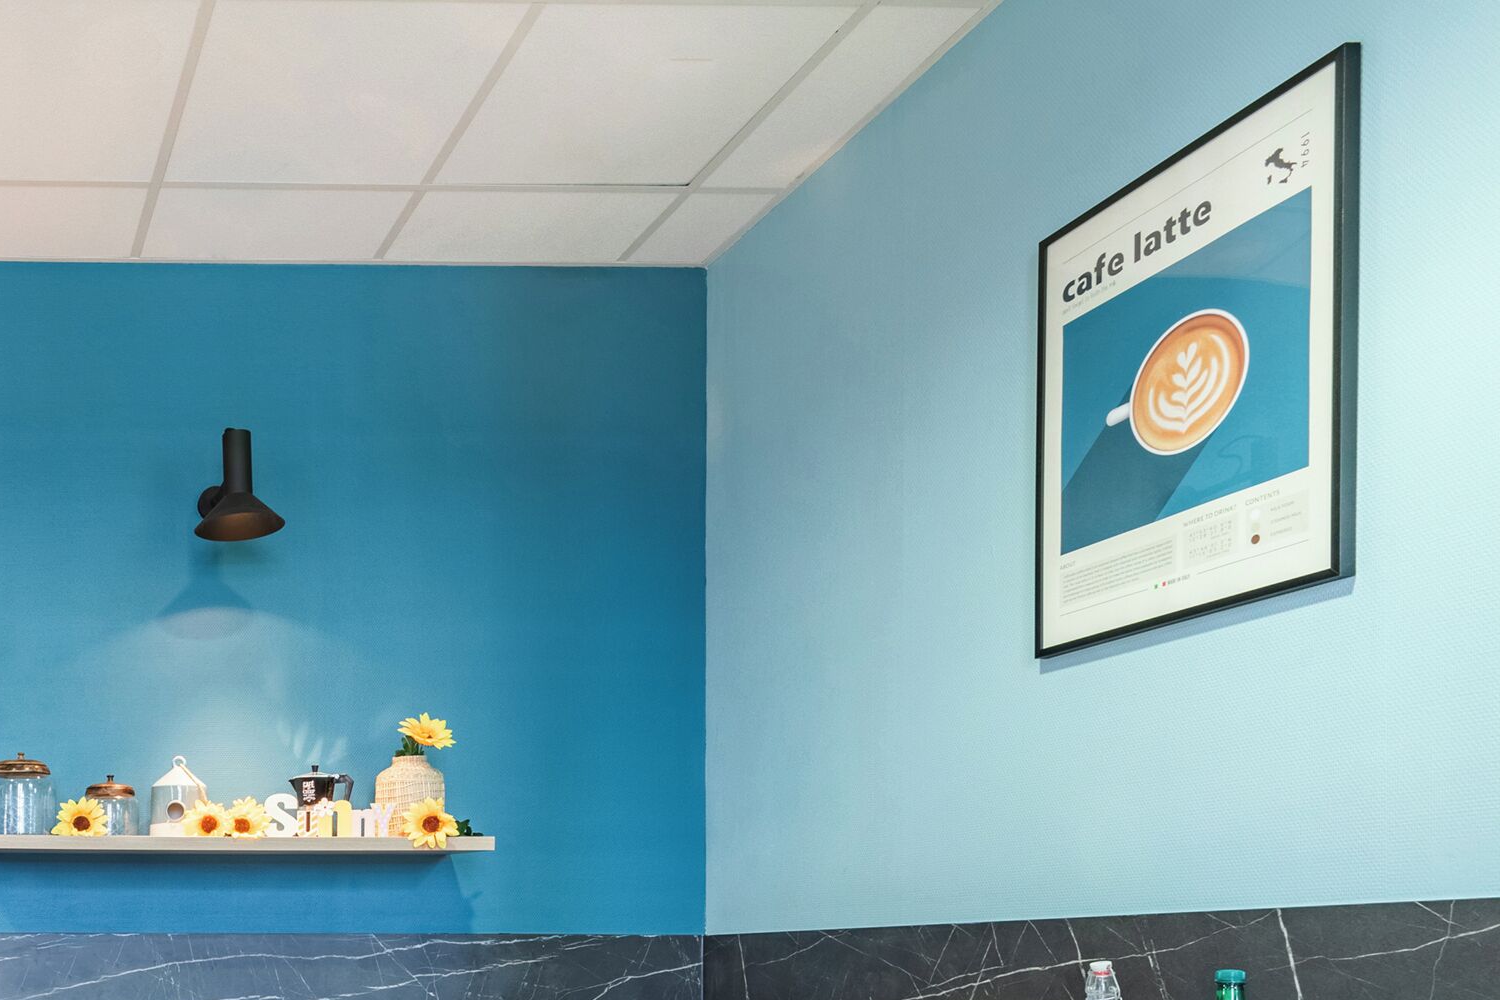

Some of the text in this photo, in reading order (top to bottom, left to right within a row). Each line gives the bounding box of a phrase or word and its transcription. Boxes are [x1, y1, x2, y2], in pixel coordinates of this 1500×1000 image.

[1062, 252, 1125, 303] cafe
[1133, 200, 1213, 264] latte
[1244, 489, 1280, 507] CONTENTS
